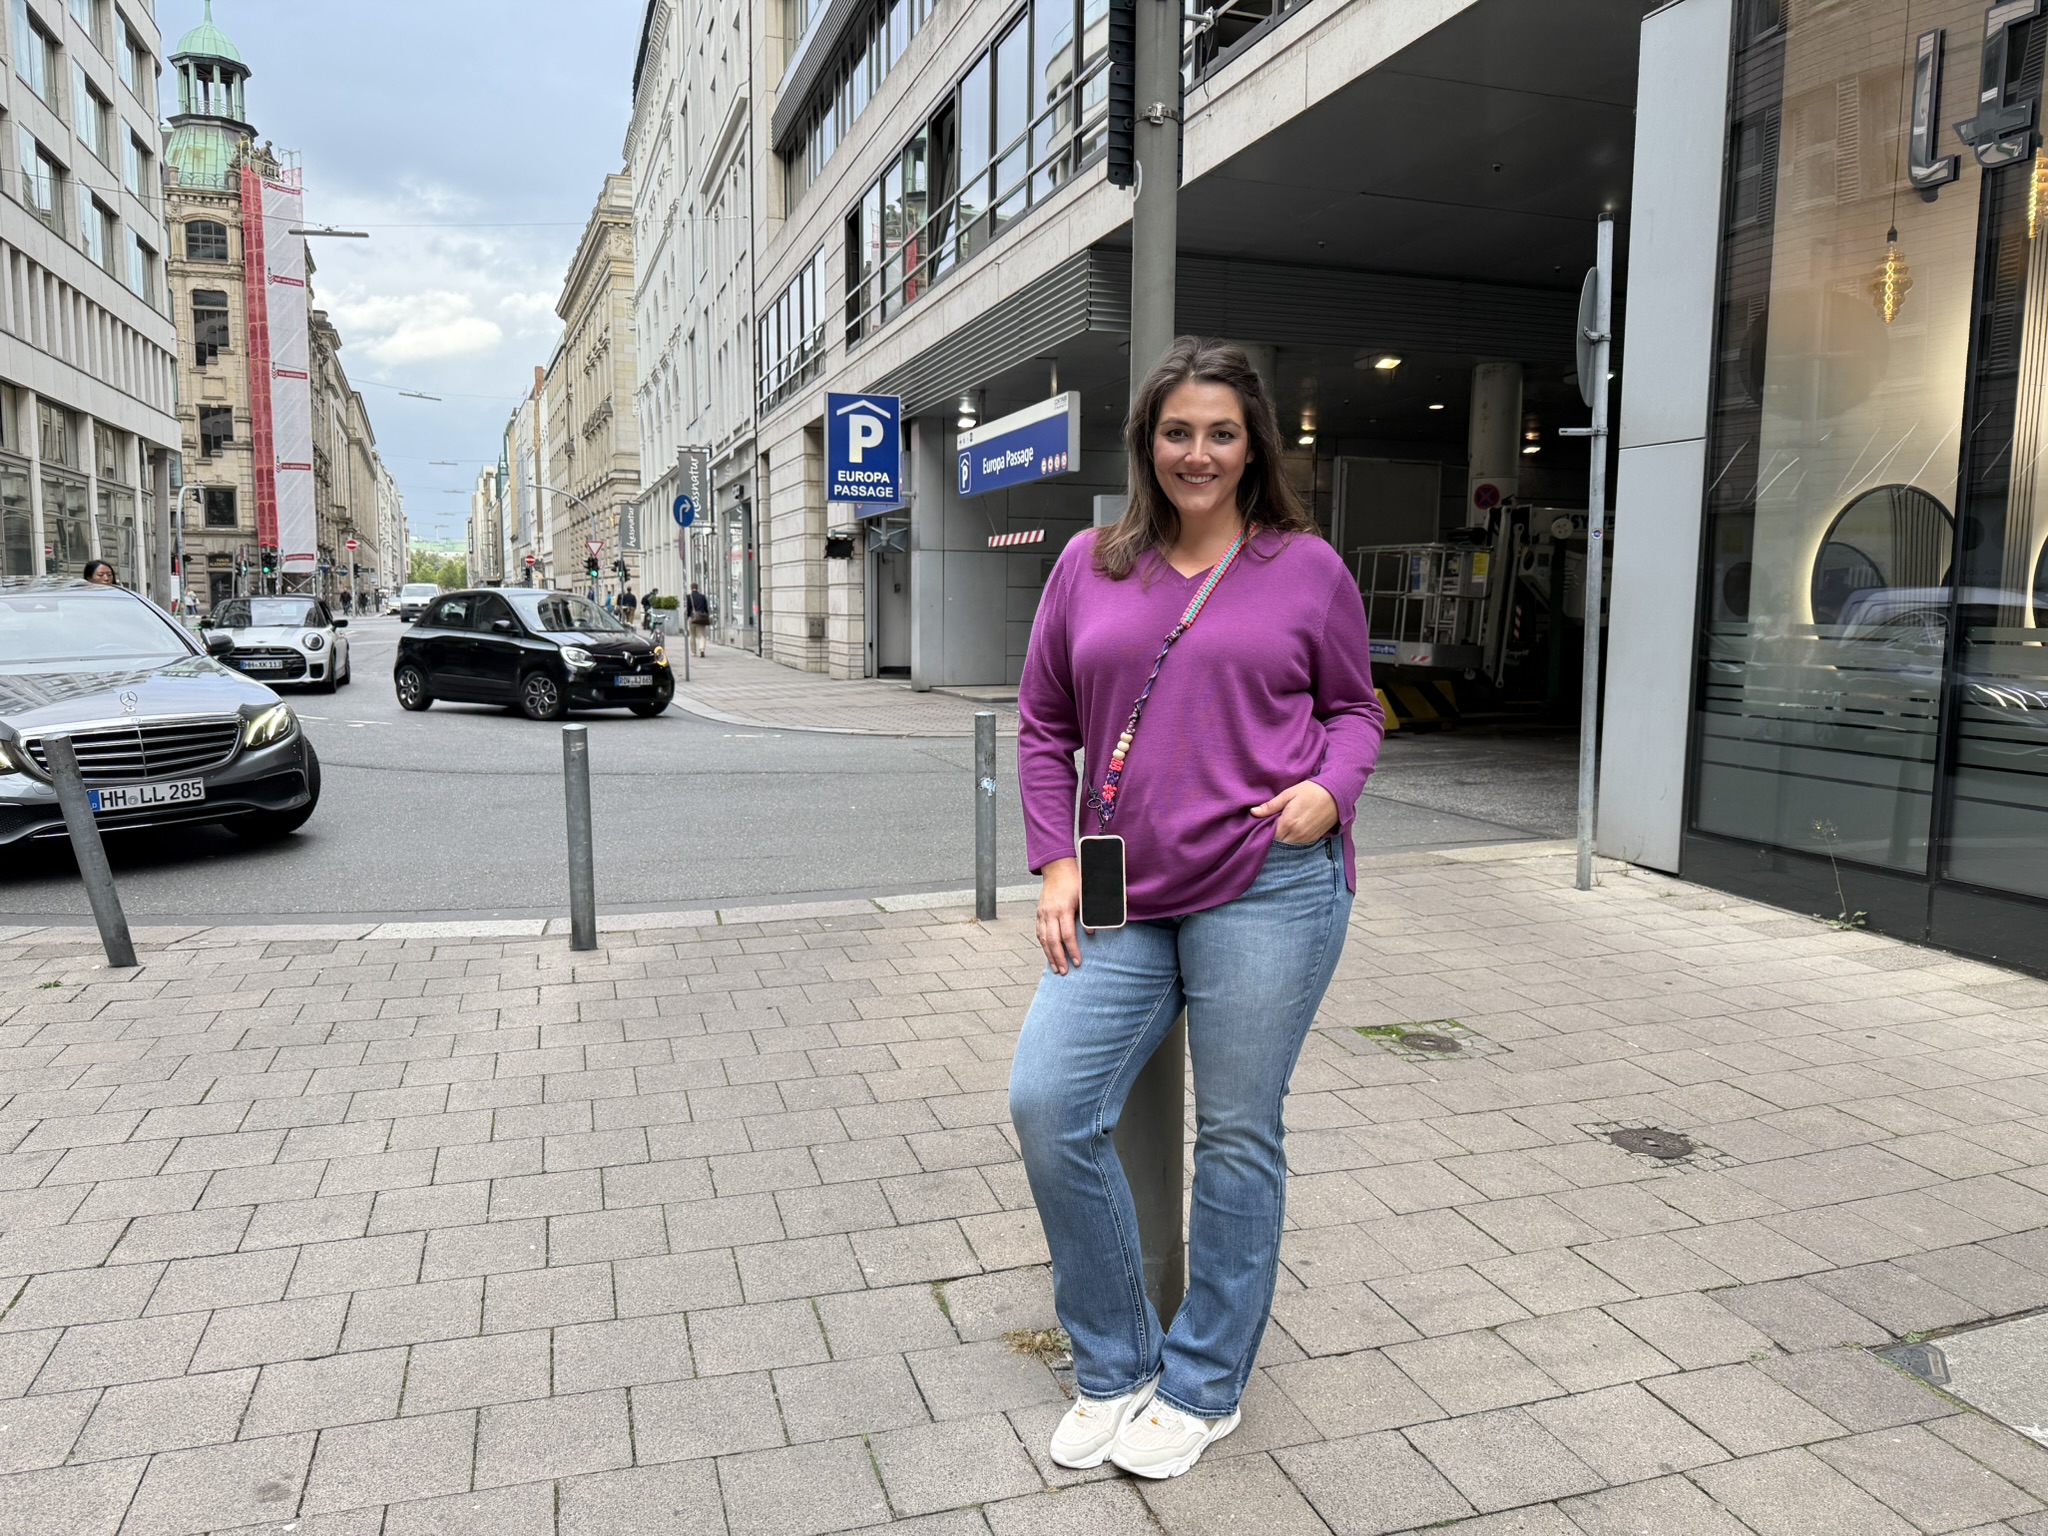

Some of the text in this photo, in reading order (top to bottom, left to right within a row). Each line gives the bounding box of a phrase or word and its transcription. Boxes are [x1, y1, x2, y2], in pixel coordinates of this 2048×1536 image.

[849, 414, 884, 463] P
[983, 447, 1033, 475] Europa Passage
[838, 470, 890, 484] EUROPA
[834, 485, 893, 498] PASSAGE
[626, 506, 636, 548] hessnatur
[100, 790, 127, 808] HH
[140, 786, 165, 804] LL
[169, 781, 202, 800] 285
